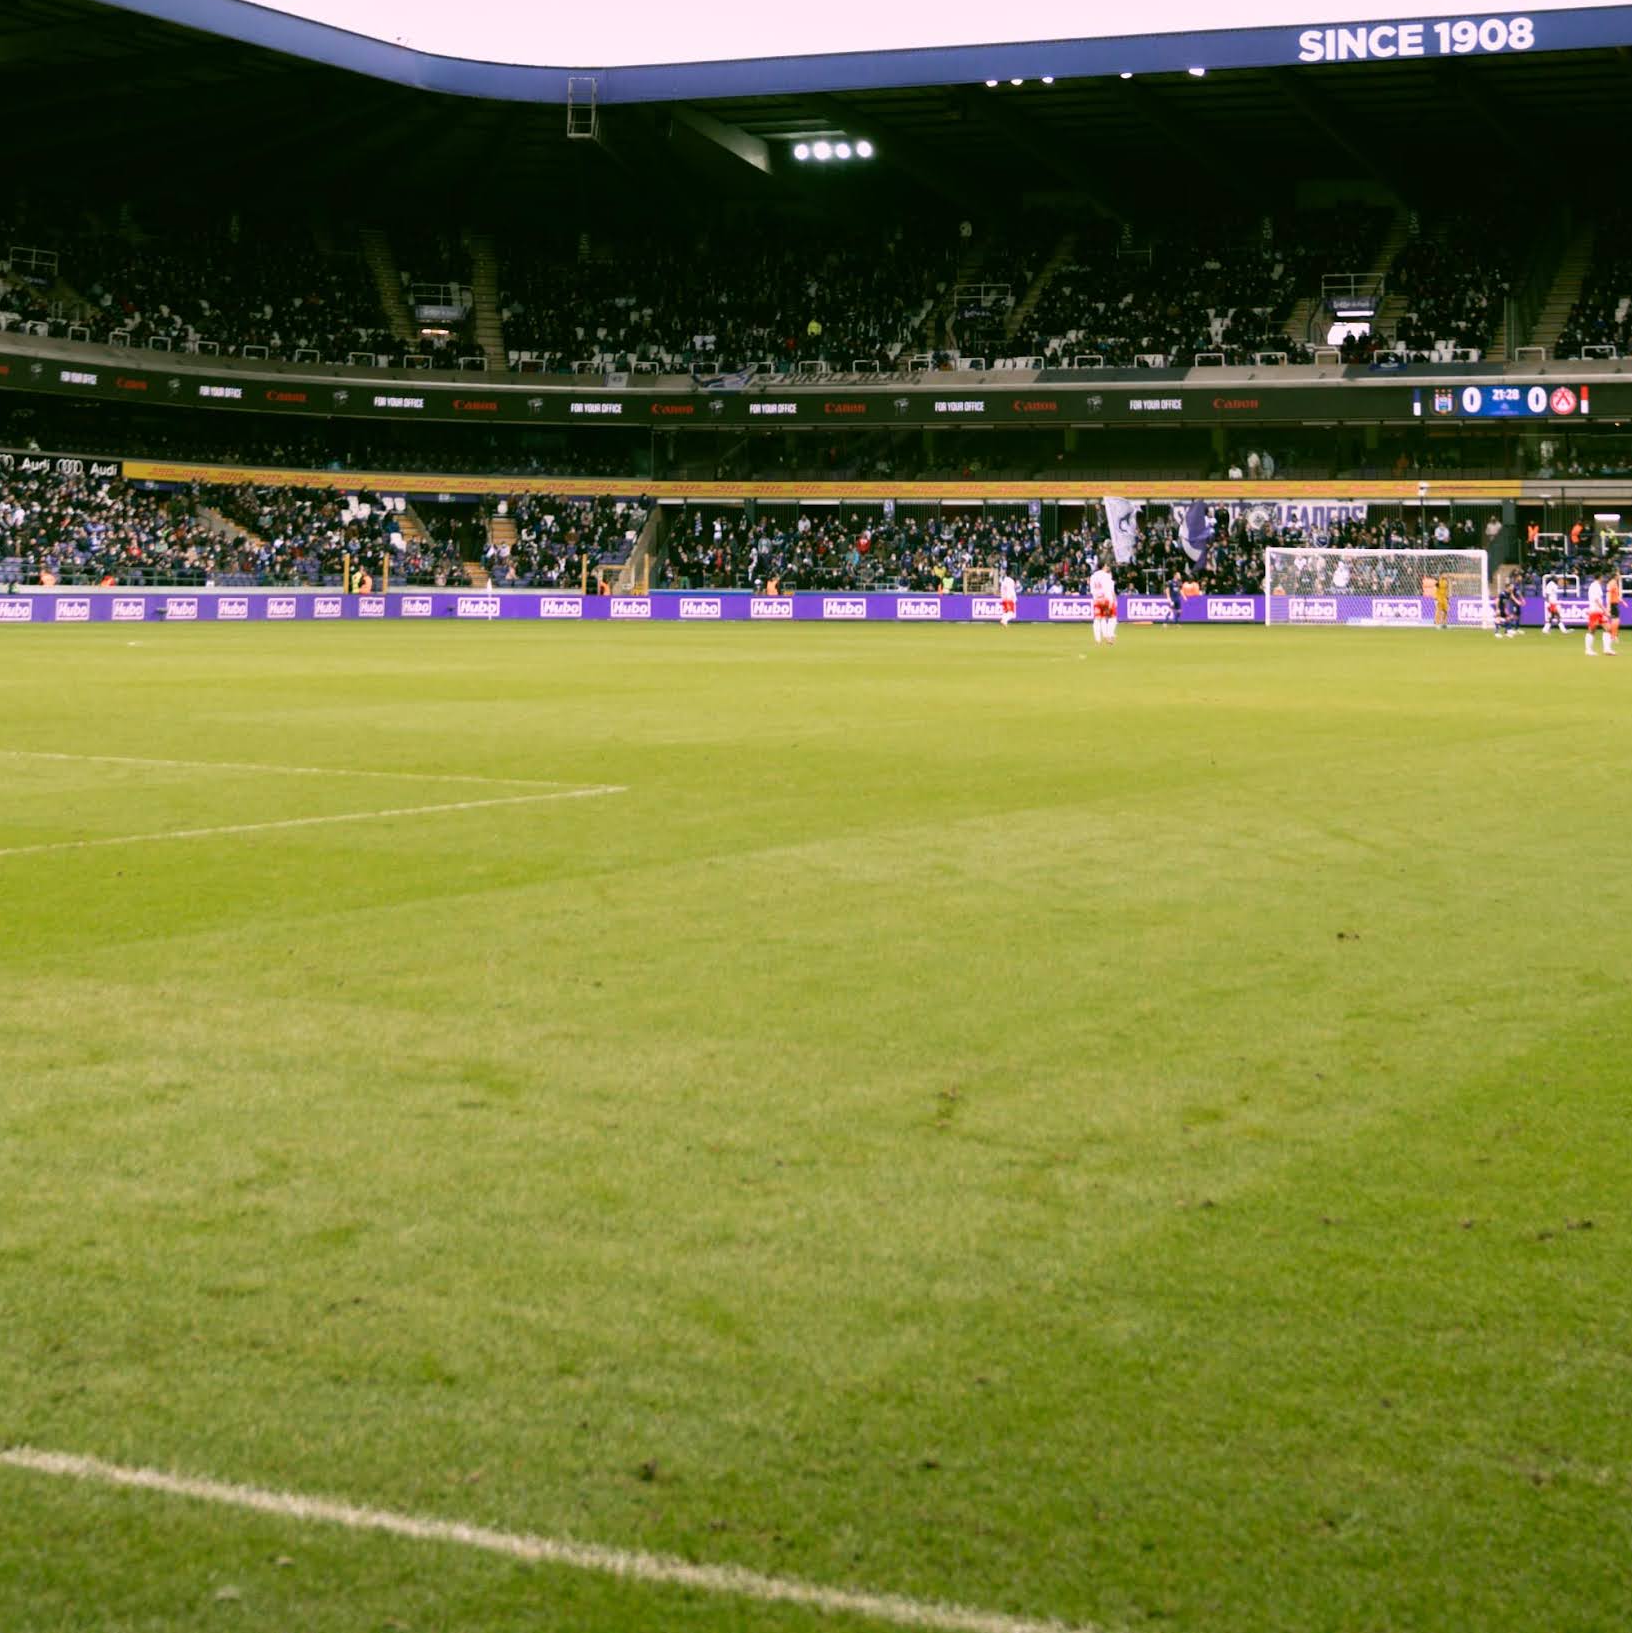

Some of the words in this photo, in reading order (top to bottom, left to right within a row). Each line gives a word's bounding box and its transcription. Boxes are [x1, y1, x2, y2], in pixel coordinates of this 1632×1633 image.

[1294, 25, 1425, 62] SINCE
[1433, 16, 1535, 54] 1908
[374, 397, 386, 406] FOR
[386, 398, 402, 407] YOUR
[403, 398, 423, 408] OFFICE
[1130, 400, 1142, 410] FOR
[1143, 400, 1159, 410] YOUR
[1160, 399, 1181, 409] OFFICE
[1212, 399, 1259, 410] Canon
[1462, 387, 1482, 413] 0
[1492, 388, 1521, 401] 21:28
[1527, 387, 1548, 413] 0
[571, 403, 583, 412] FOR
[584, 403, 600, 413] YOUR
[601, 404, 621, 413] OFFICE
[750, 404, 761, 413] FOR
[762, 404, 776, 413] YOUR
[777, 404, 796, 413] OFFICE
[935, 402, 947, 411] FOR
[947, 402, 963, 411] YOUR
[964, 402, 984, 411] OFFICE
[57, 602, 87, 618] Hubo
[114, 602, 143, 617] Hubo
[167, 601, 195, 616] Hubo
[220, 601, 246, 616] Hubo
[269, 601, 294, 616] Hubo
[316, 601, 339, 615] Hubo
[360, 600, 382, 614] Hubo
[404, 600, 429, 614] Hubo
[460, 601, 497, 614] Hubo
[543, 601, 579, 615] Hubo
[613, 601, 648, 615] Hubo
[682, 601, 718, 616] Hubo
[753, 601, 789, 616] Hubo
[825, 601, 863, 616] Hubo
[899, 601, 937, 616] Hubo
[975, 602, 1004, 615] Hub
[1052, 602, 1091, 616] Hubo
[1210, 602, 1250, 617] Hubo
[1558, 604, 1590, 619] ubo
